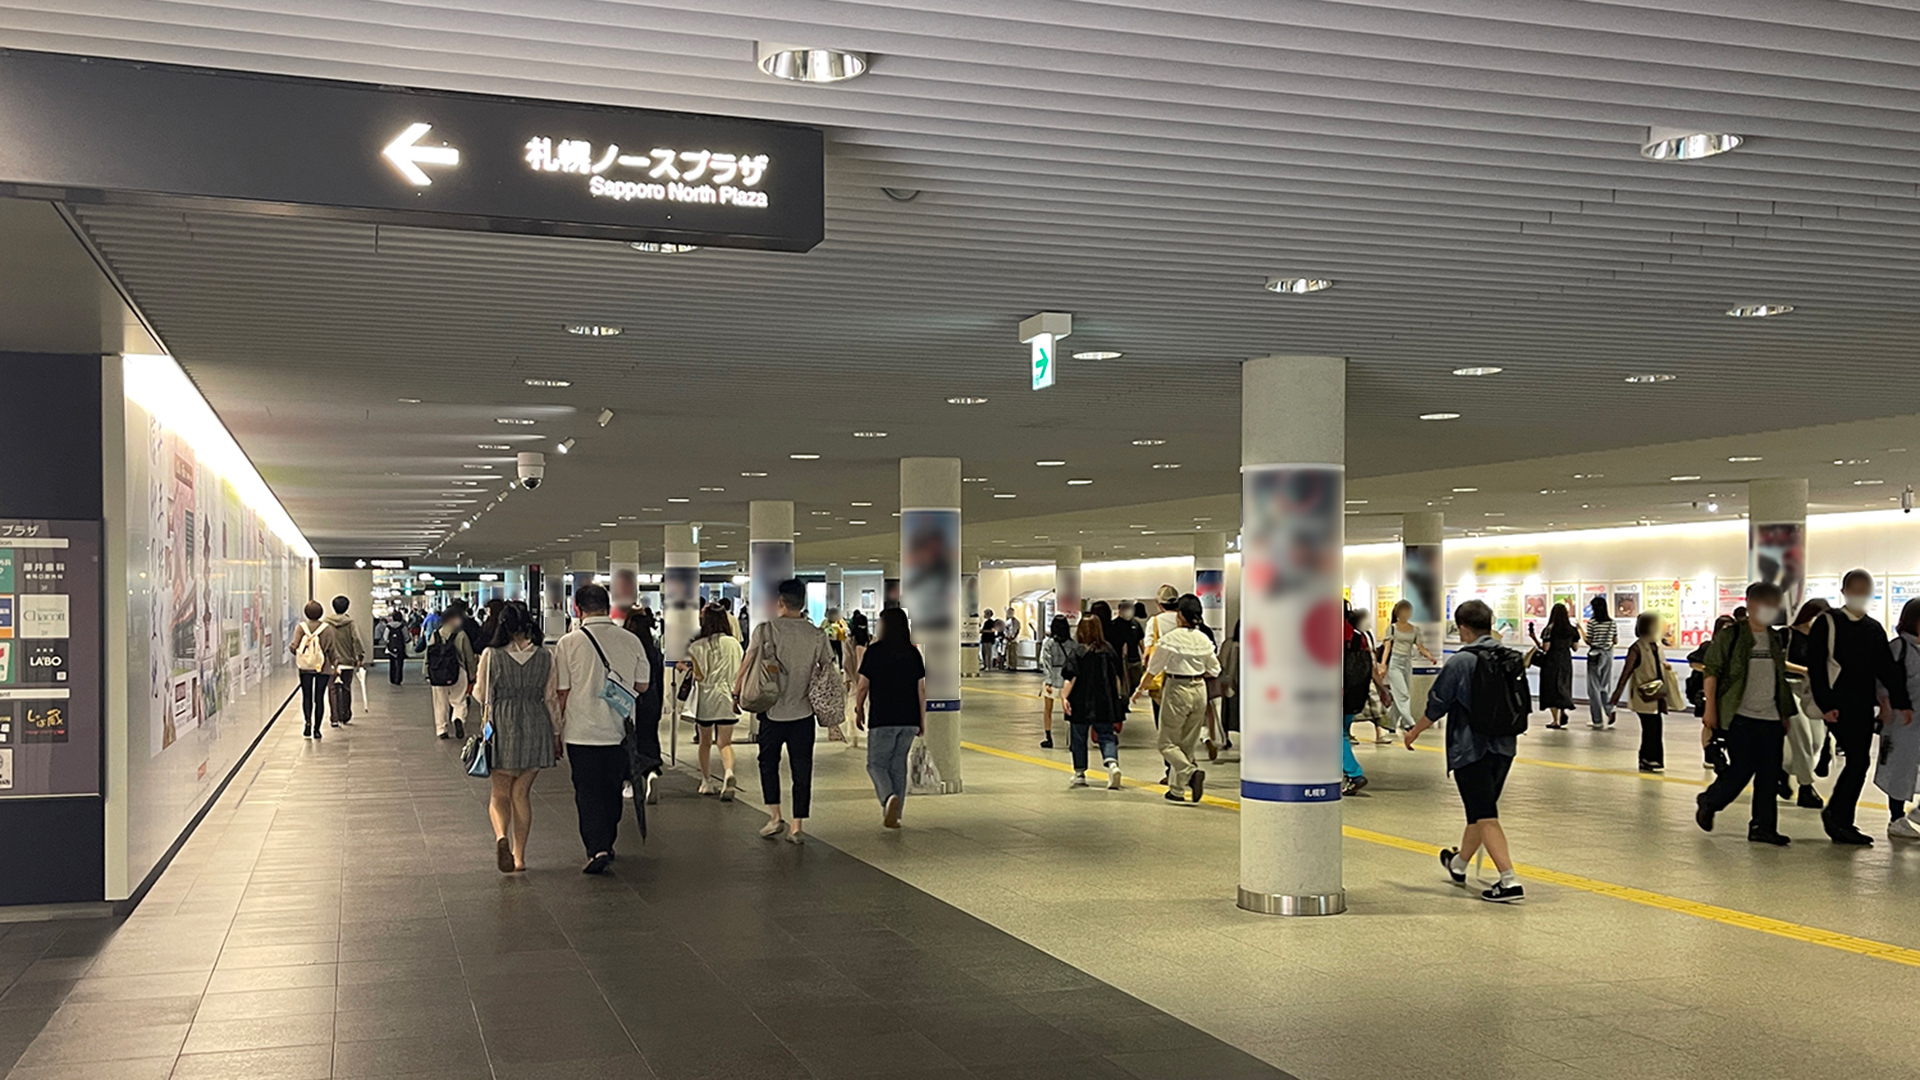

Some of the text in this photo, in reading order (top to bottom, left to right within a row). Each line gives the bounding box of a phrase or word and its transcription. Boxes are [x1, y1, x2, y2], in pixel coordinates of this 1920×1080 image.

[525, 136, 769, 187] 札幌ノースプラザ
[589, 175, 769, 208] Sapporo North Plaza
[23, 610, 65, 621] Chacott
